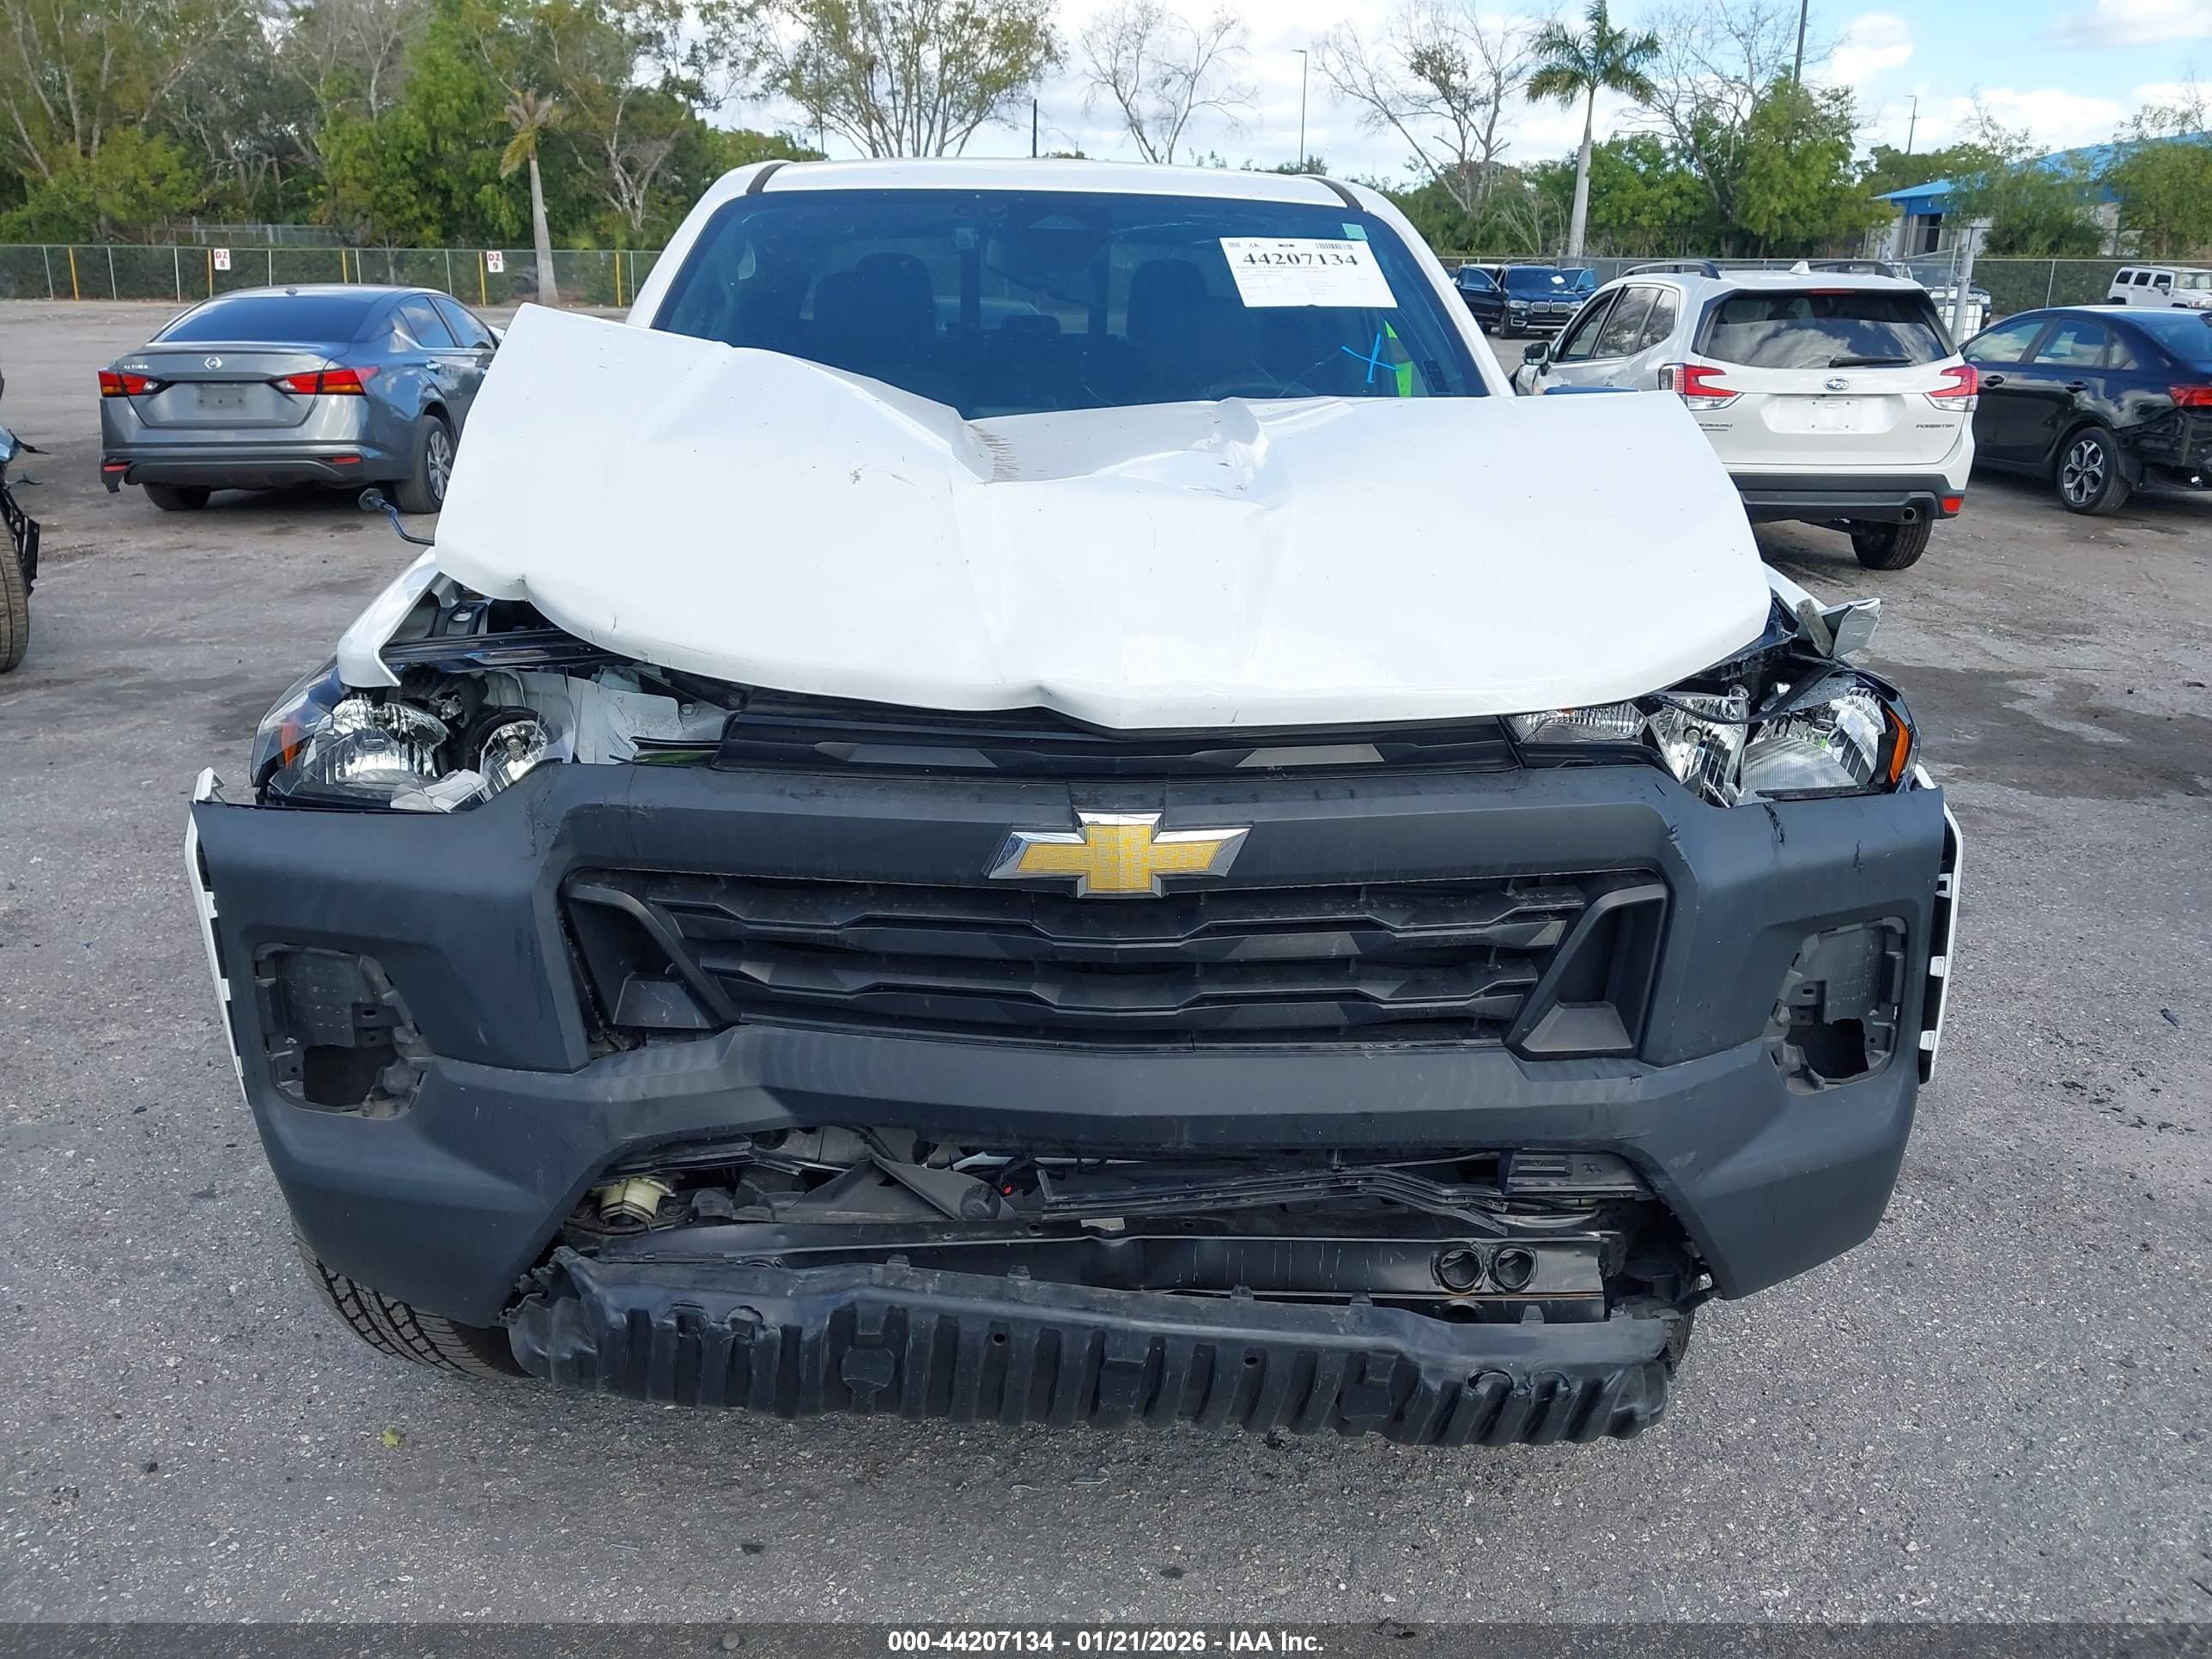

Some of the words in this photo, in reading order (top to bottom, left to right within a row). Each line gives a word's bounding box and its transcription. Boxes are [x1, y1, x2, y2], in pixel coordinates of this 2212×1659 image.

[488, 252, 501, 261] DZ
[1243, 252, 1359, 266] 44207134
[492, 262, 499, 270] 9
